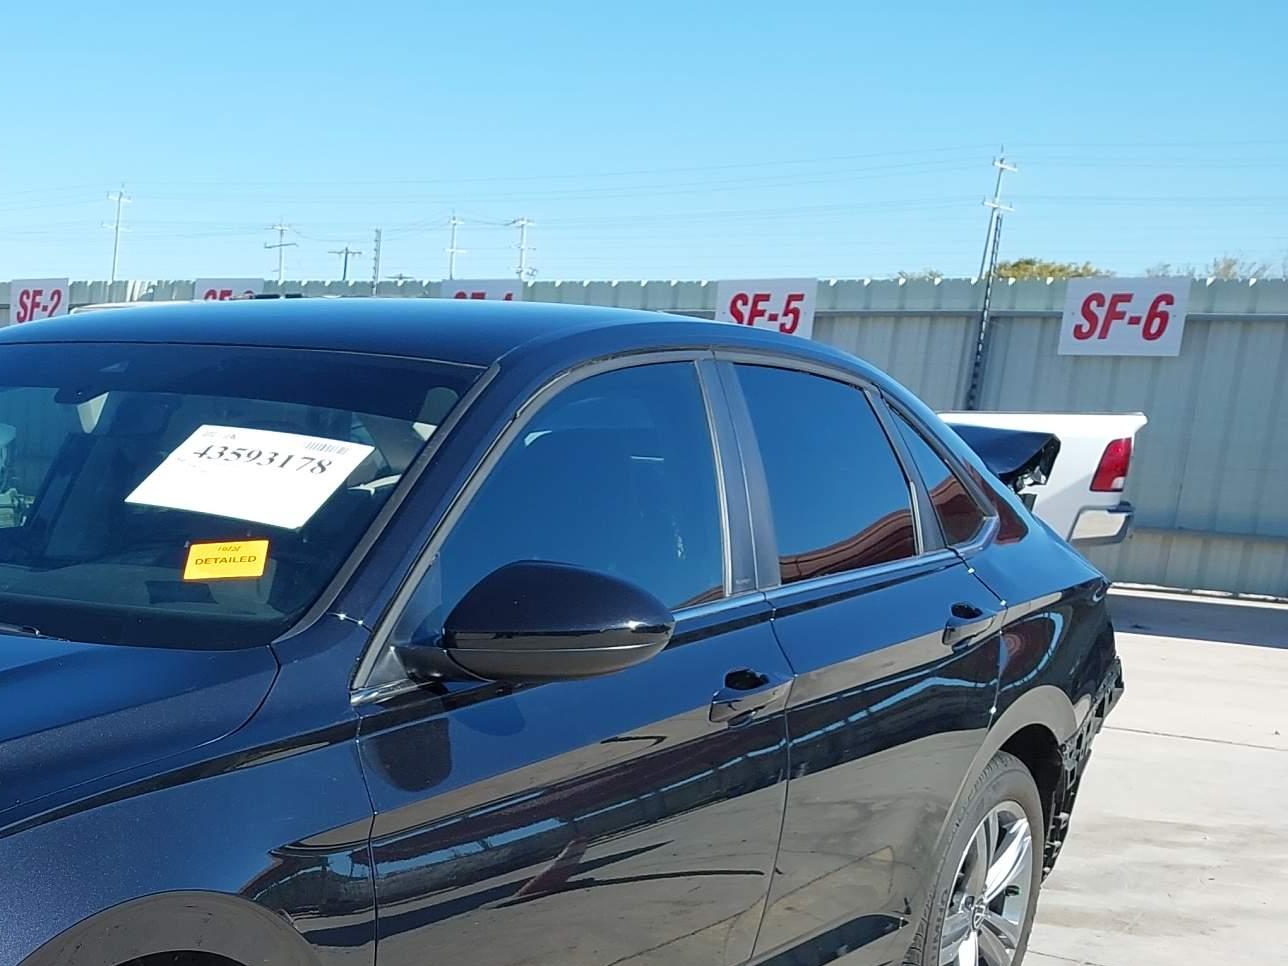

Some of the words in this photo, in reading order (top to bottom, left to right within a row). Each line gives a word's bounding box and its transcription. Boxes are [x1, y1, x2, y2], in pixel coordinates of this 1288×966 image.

[17, 289, 62, 323] SF-2
[730, 293, 805, 334] SF-5
[1073, 292, 1175, 341] SF-6
[193, 445, 333, 474] 43593178
[195, 555, 257, 565] DETAILED
